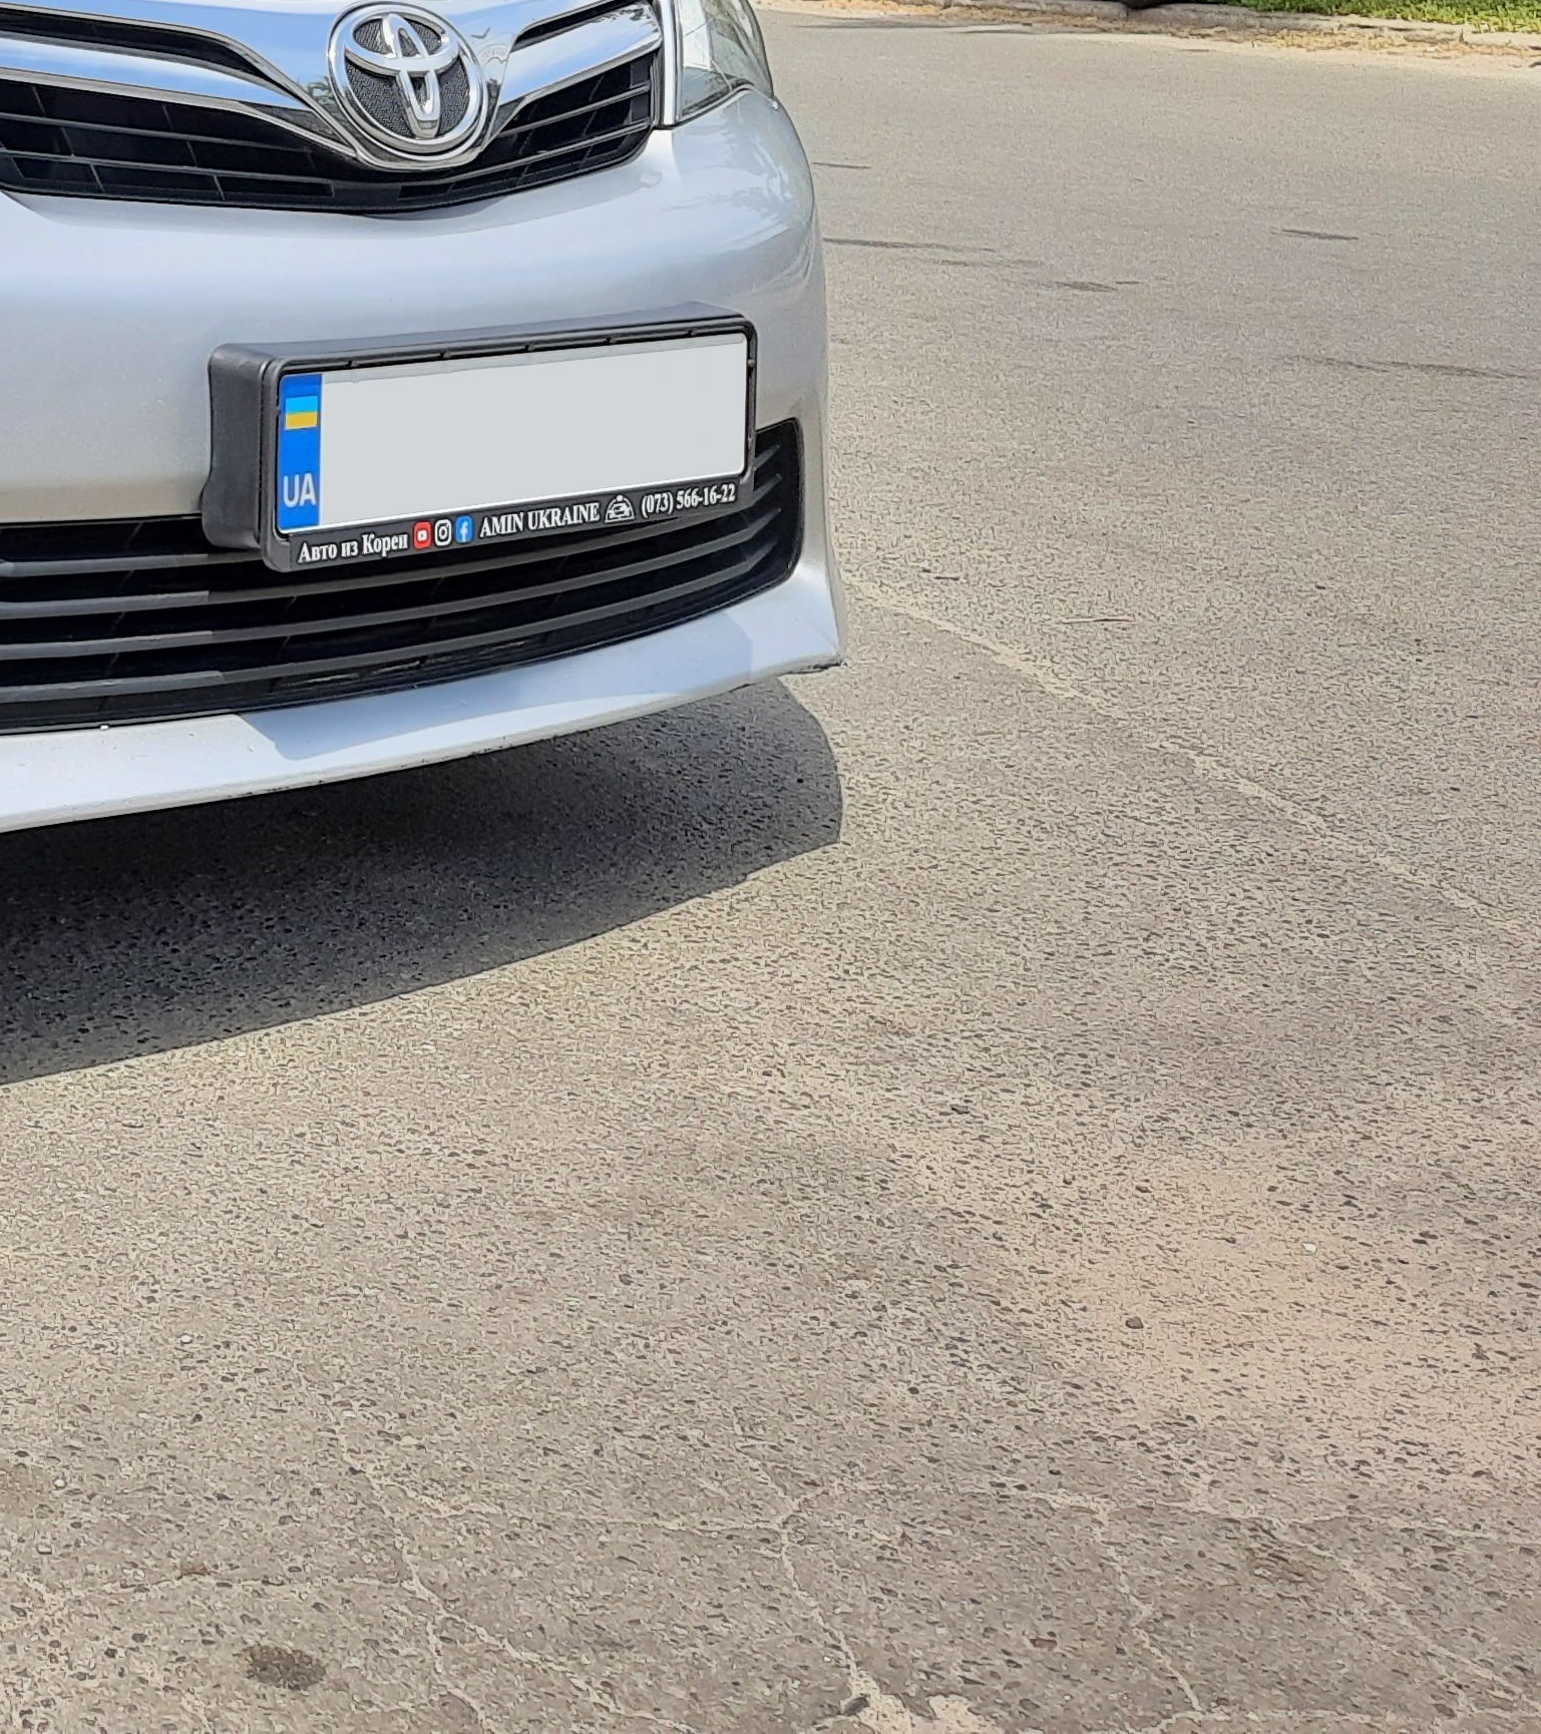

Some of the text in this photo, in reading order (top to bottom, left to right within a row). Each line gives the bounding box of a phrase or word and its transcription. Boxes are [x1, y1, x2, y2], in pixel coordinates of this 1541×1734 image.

[283, 472, 317, 508] UA
[296, 541, 338, 564] Авто
[341, 541, 358, 558] из
[361, 532, 409, 558] Кореи
[479, 511, 524, 539] AMIN
[527, 502, 600, 531] UKRAINE
[641, 492, 674, 519] (073)
[675, 483, 737, 510] 566-16-22
